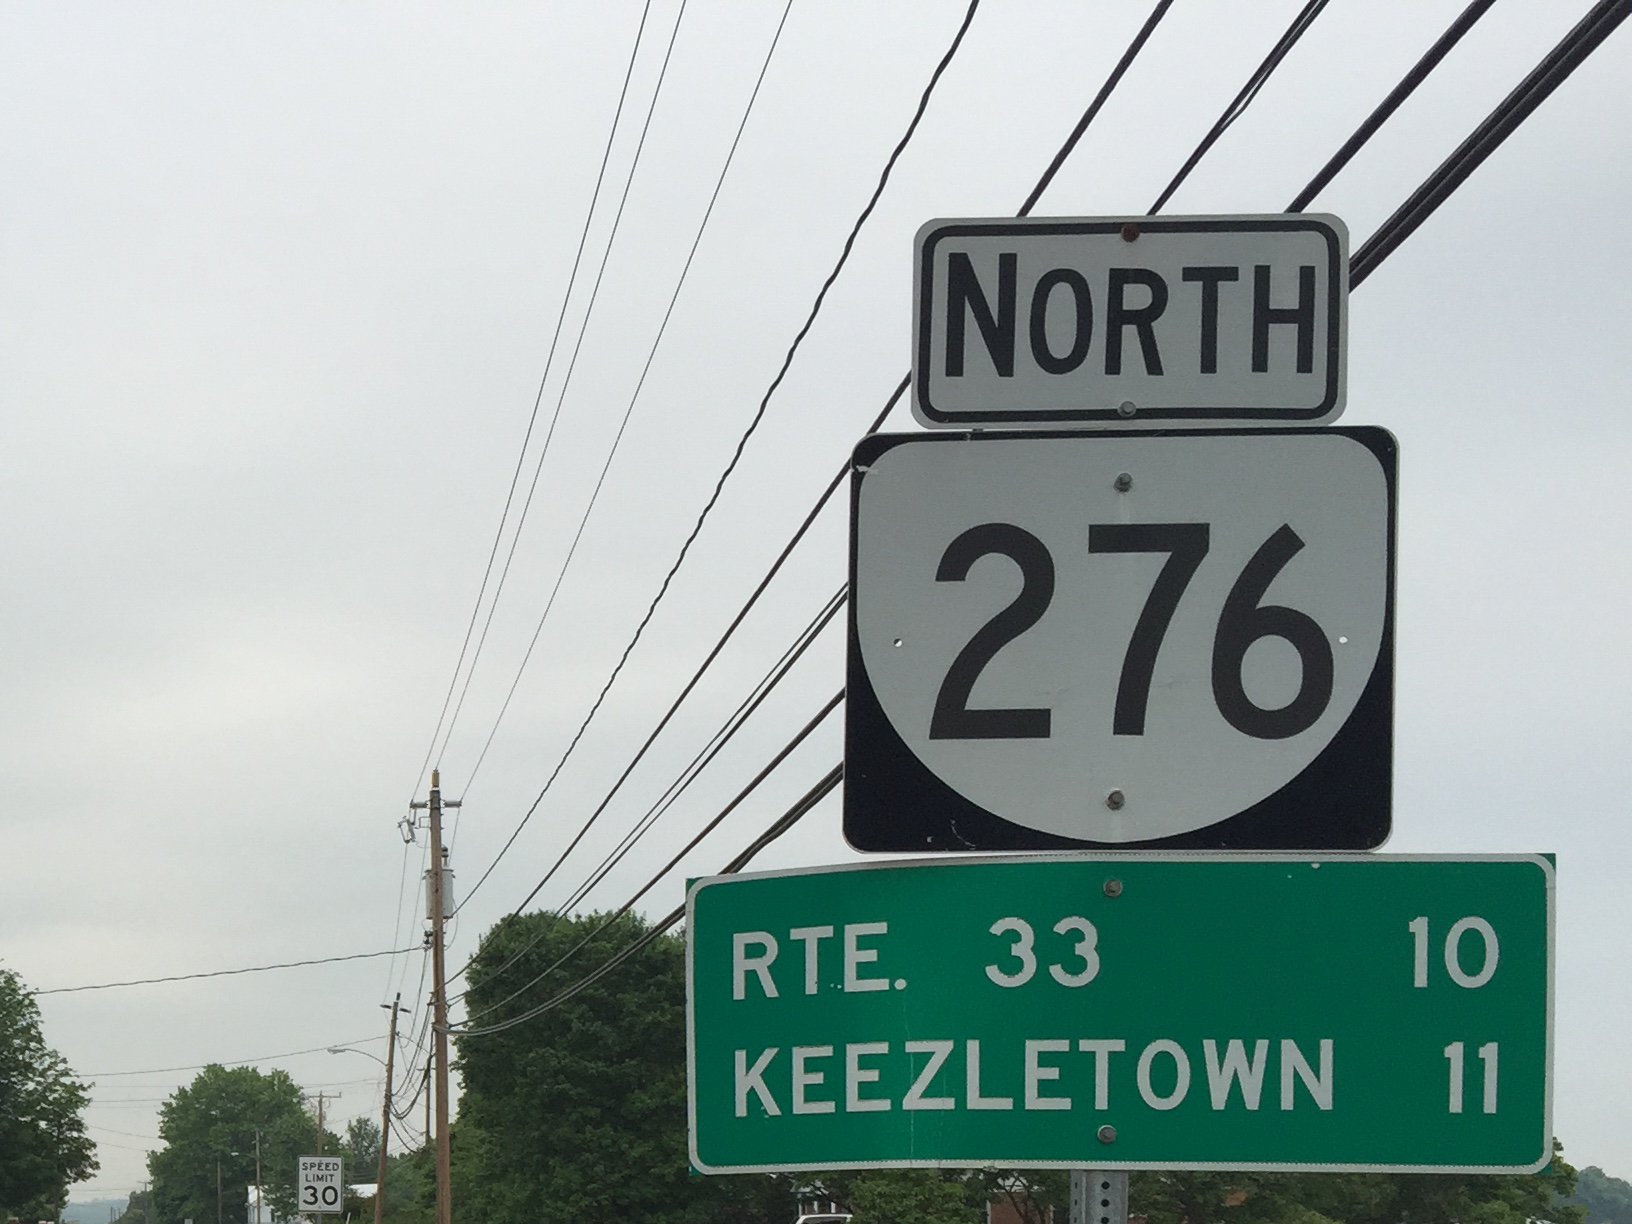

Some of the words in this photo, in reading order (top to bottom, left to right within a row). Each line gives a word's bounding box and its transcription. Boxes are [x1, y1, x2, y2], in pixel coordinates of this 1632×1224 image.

[945, 252, 1316, 378] NORTH
[929, 523, 1334, 741] 276
[733, 922, 908, 1001] RTE.
[985, 915, 1101, 988] 33
[1408, 916, 1500, 989] 10
[734, 1038, 1335, 1118] KEEZLETOWN
[1443, 1041, 1499, 1114] 11
[301, 1162, 340, 1171] SPEED
[303, 1185, 338, 1206] 30
[305, 1174, 335, 1183] LIMIT
